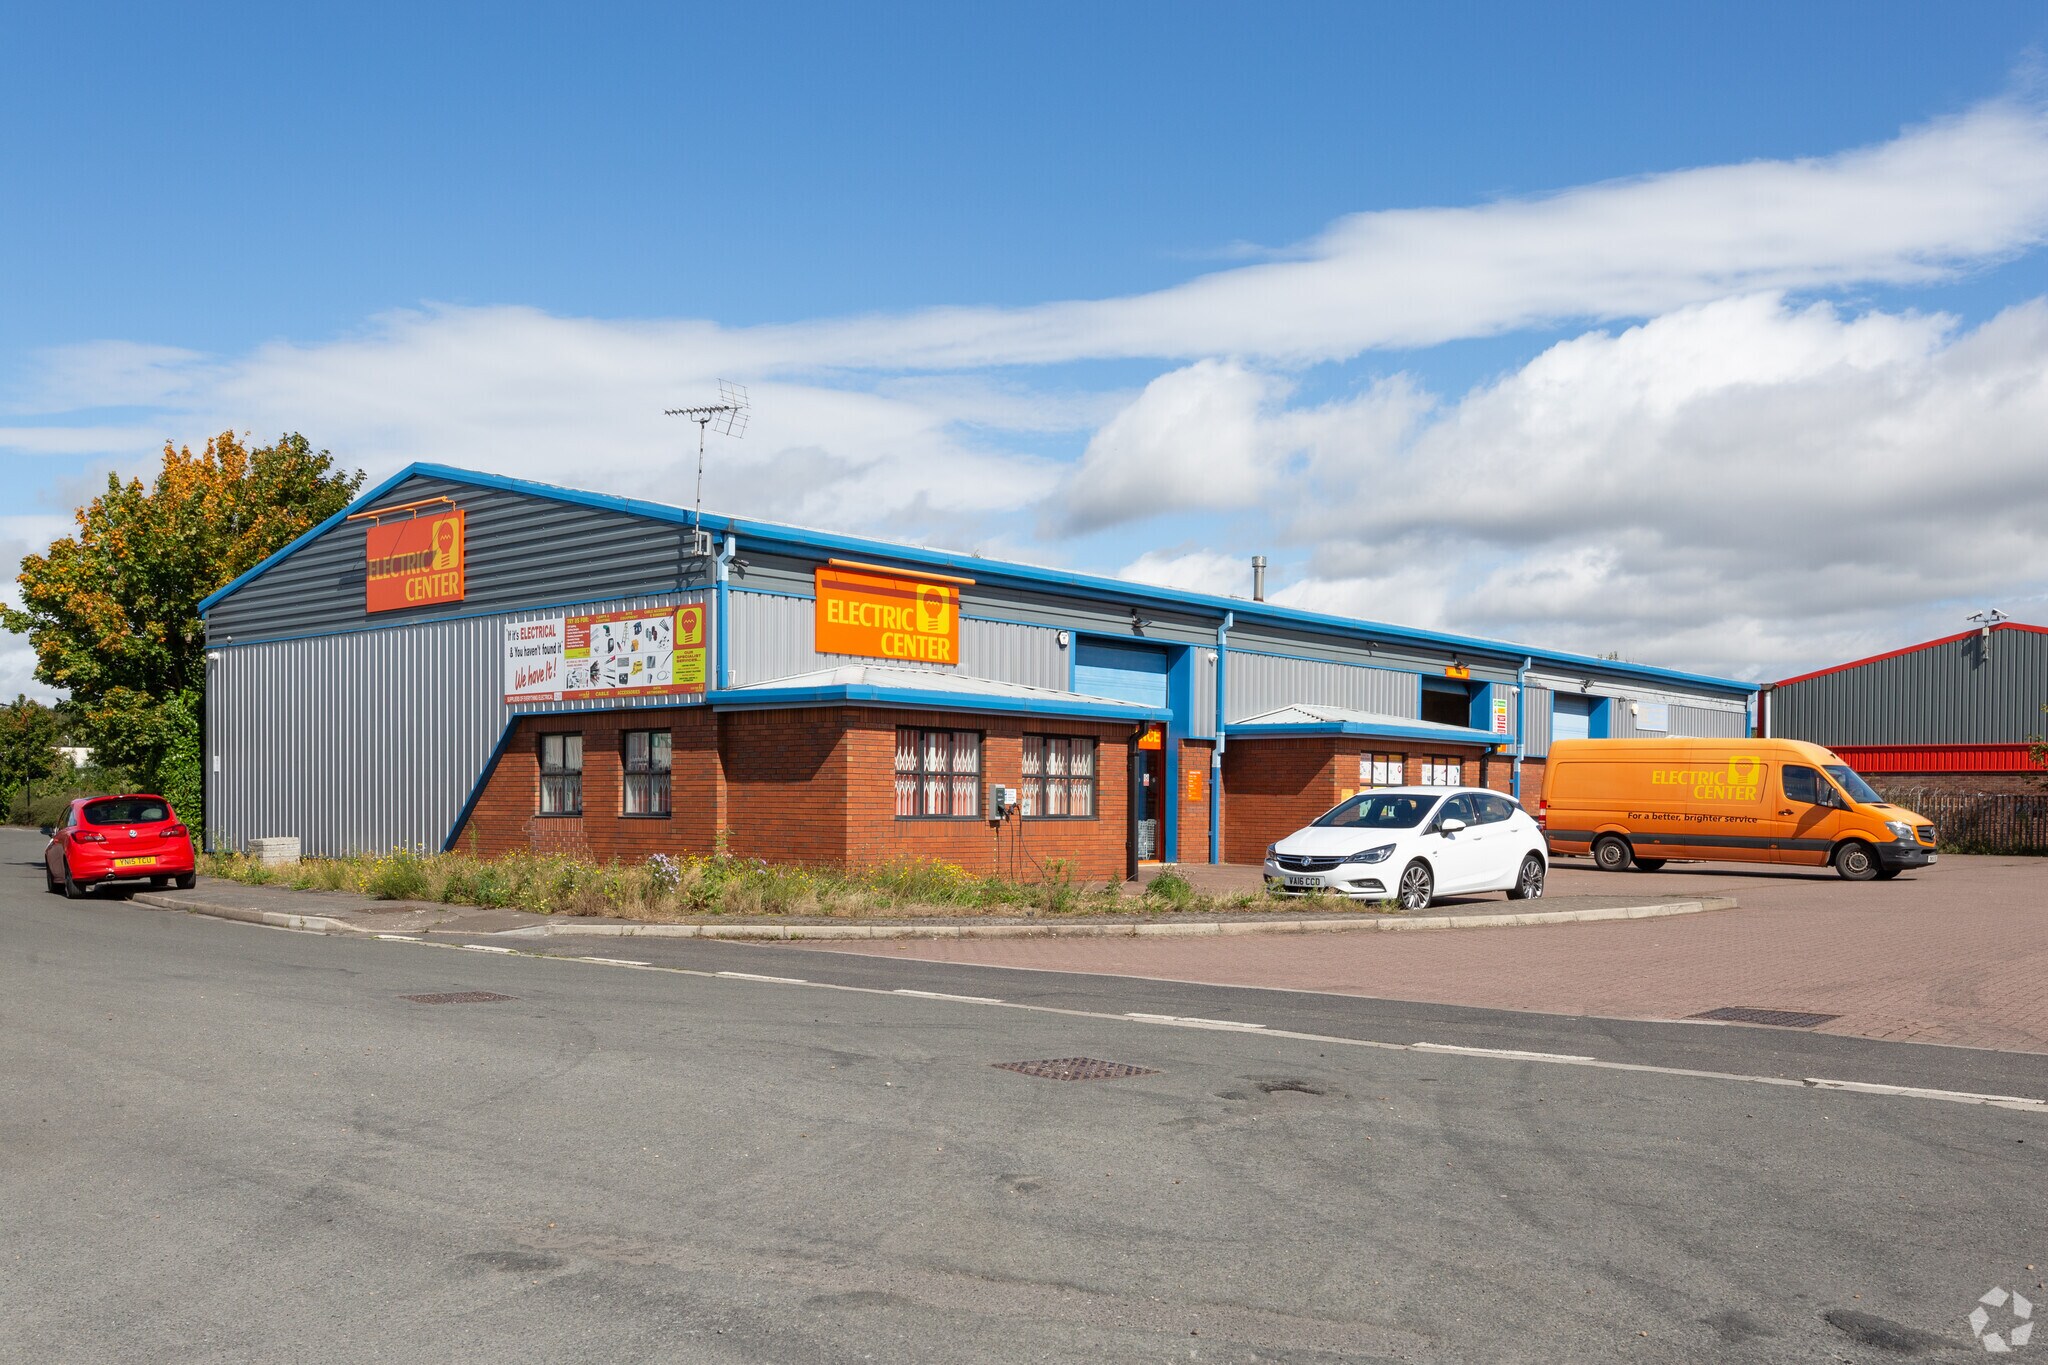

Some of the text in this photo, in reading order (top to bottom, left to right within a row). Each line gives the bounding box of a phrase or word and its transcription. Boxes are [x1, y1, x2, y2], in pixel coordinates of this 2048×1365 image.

[367, 549, 430, 581] ELECTRIC
[405, 571, 459, 601] CENTER
[827, 599, 914, 631] ELECTRIC
[521, 624, 556, 640] ELECTRICAL
[510, 648, 514, 658] &
[514, 646, 523, 657] You
[524, 645, 541, 656] haven't
[542, 642, 556, 655] found
[881, 632, 950, 661] CENTER
[515, 667, 526, 690] We
[528, 665, 545, 687] have
[1651, 770, 1725, 786] ELECTRIC
[1693, 785, 1757, 801] CENTER
[1627, 812, 1642, 820] For
[1652, 812, 1681, 821] better,
[1684, 813, 1722, 823] brighter
[1724, 815, 1758, 823] service
[1290, 877, 1304, 885] VA16
